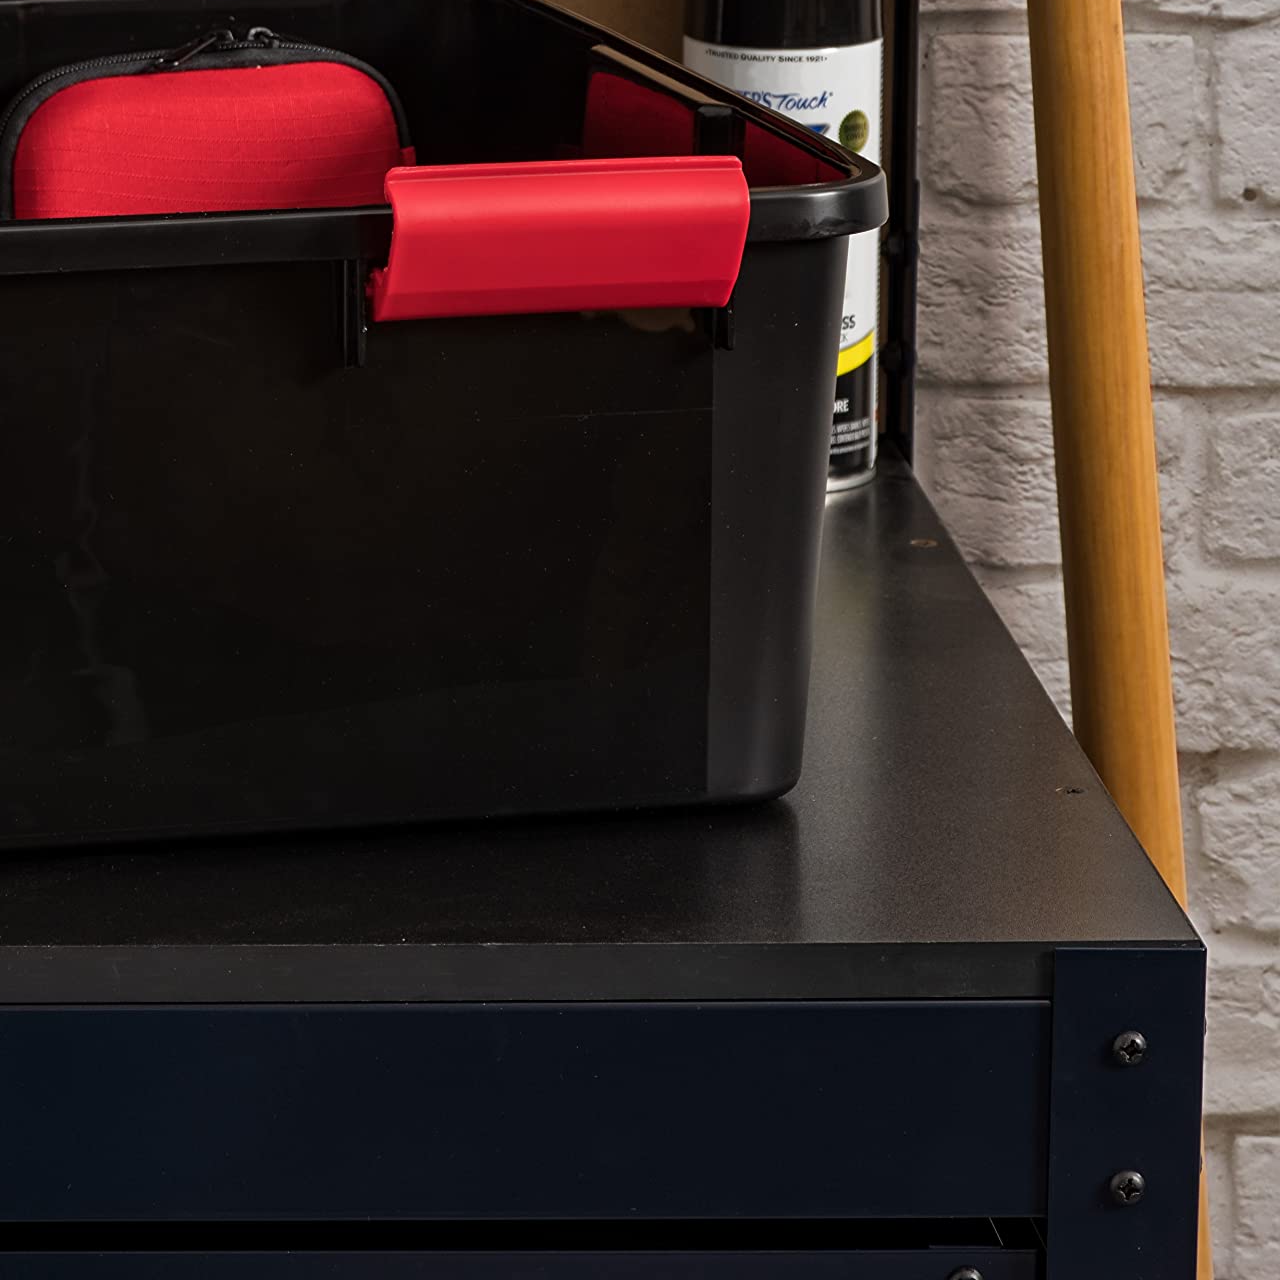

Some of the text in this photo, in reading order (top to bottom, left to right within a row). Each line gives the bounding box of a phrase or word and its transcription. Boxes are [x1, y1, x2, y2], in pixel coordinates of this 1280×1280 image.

[740, 51, 776, 63] QUALITY
[778, 52, 803, 63] SINCE
[806, 52, 825, 63] 1921
[771, 90, 829, 111] Touch
